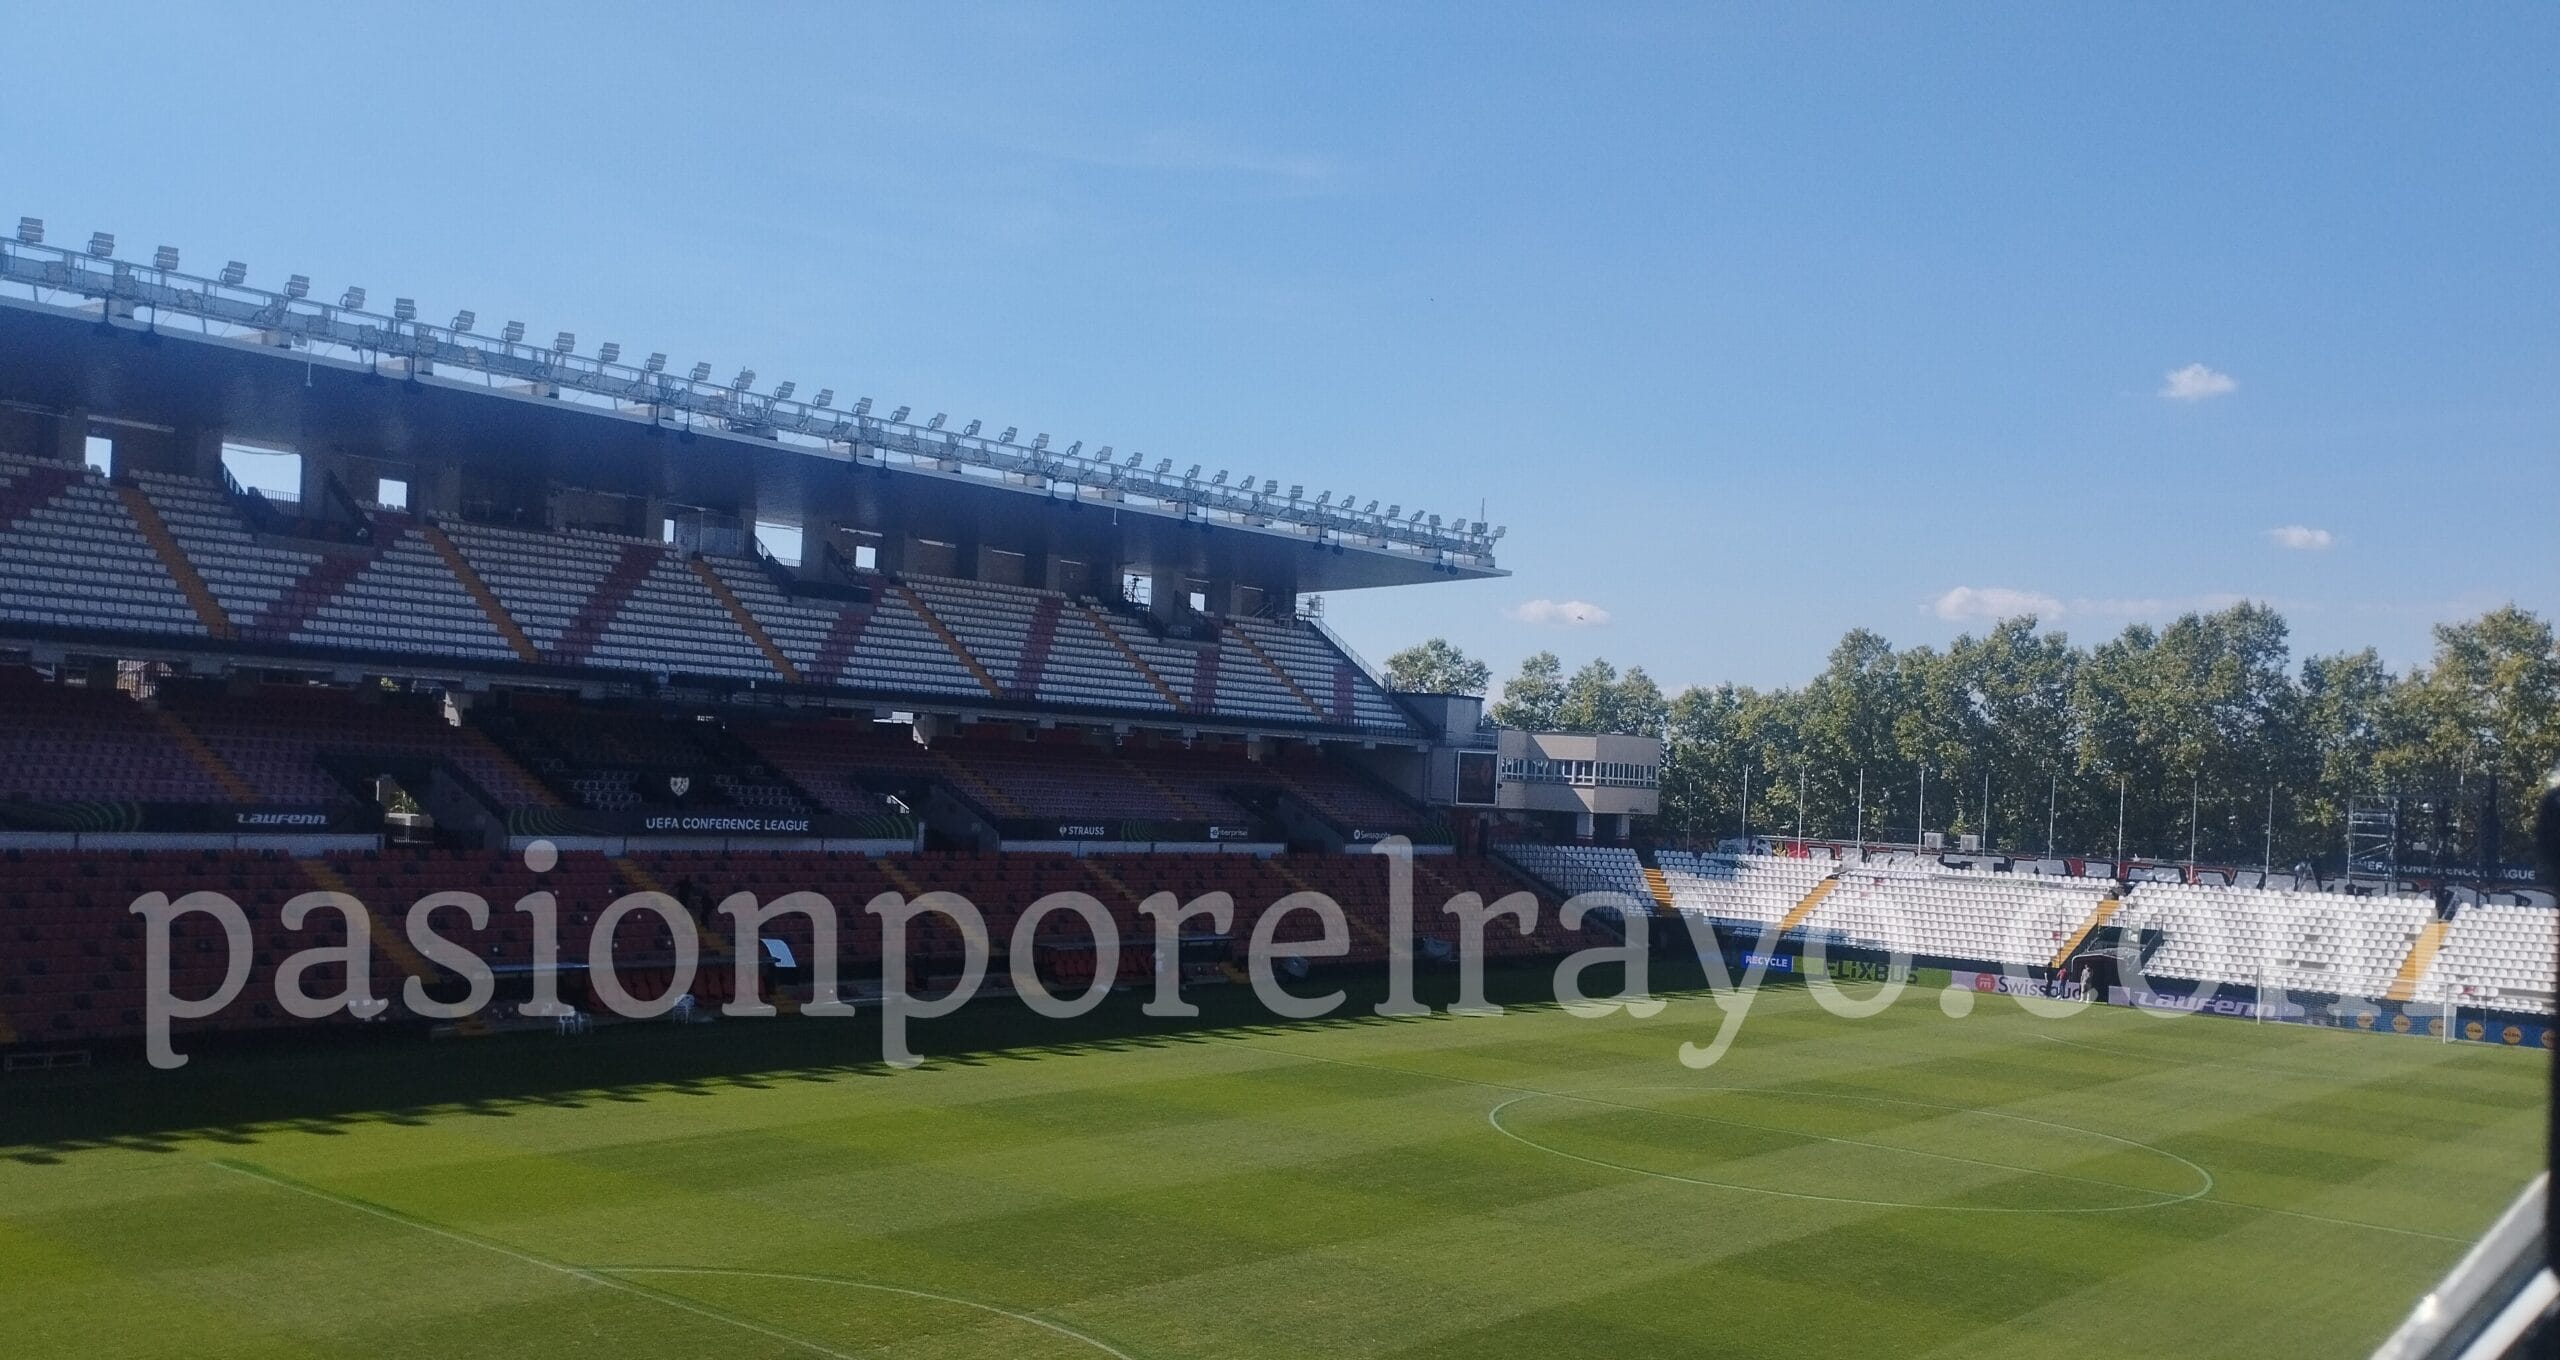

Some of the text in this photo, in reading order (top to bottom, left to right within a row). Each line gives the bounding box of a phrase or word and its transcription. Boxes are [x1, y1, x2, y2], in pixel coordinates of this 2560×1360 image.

[646, 817, 809, 831] UEFA CONFERENCE LEAGUE
[1068, 826, 1105, 836] STRAUSS
[1745, 955, 1788, 968] RECYCLE
